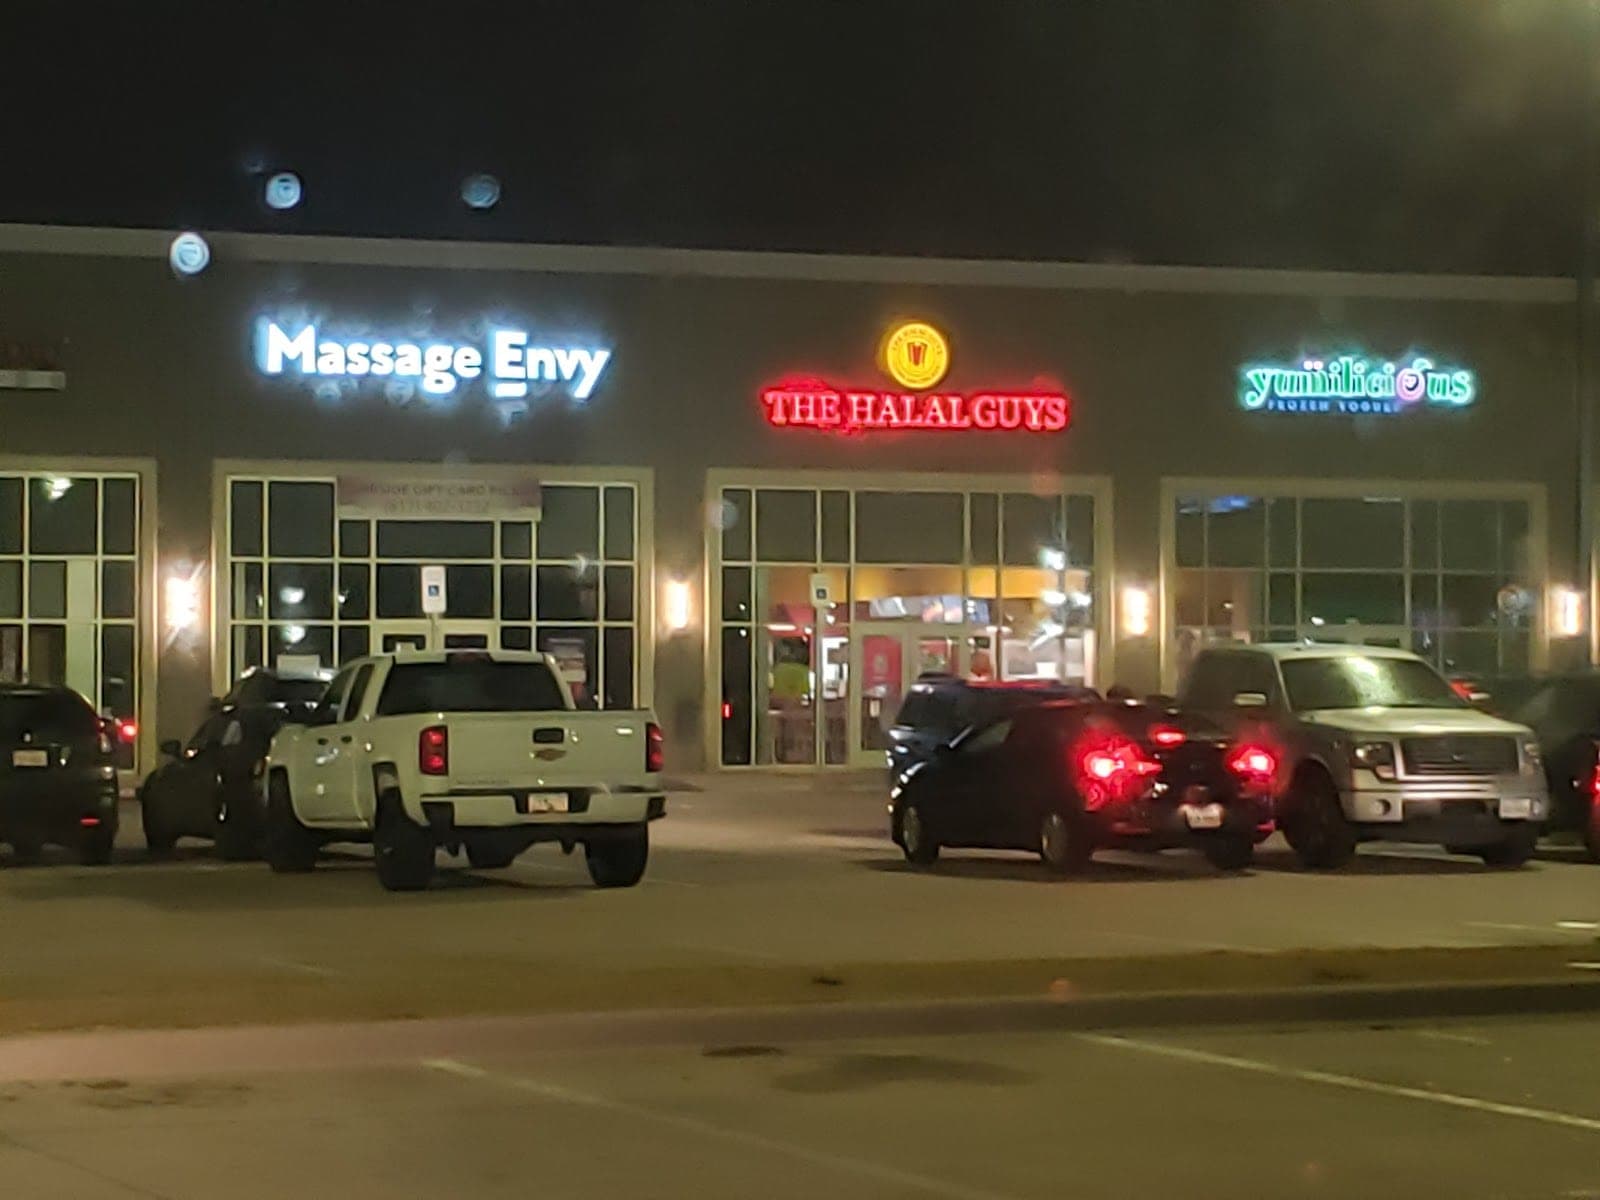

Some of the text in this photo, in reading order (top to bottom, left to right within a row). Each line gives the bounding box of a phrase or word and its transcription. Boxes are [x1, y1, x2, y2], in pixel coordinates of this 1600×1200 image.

[265, 322, 611, 399] Massage Envy
[764, 390, 1067, 430] THE HALAL GUYS
[1267, 399, 1329, 412] FROZEN
